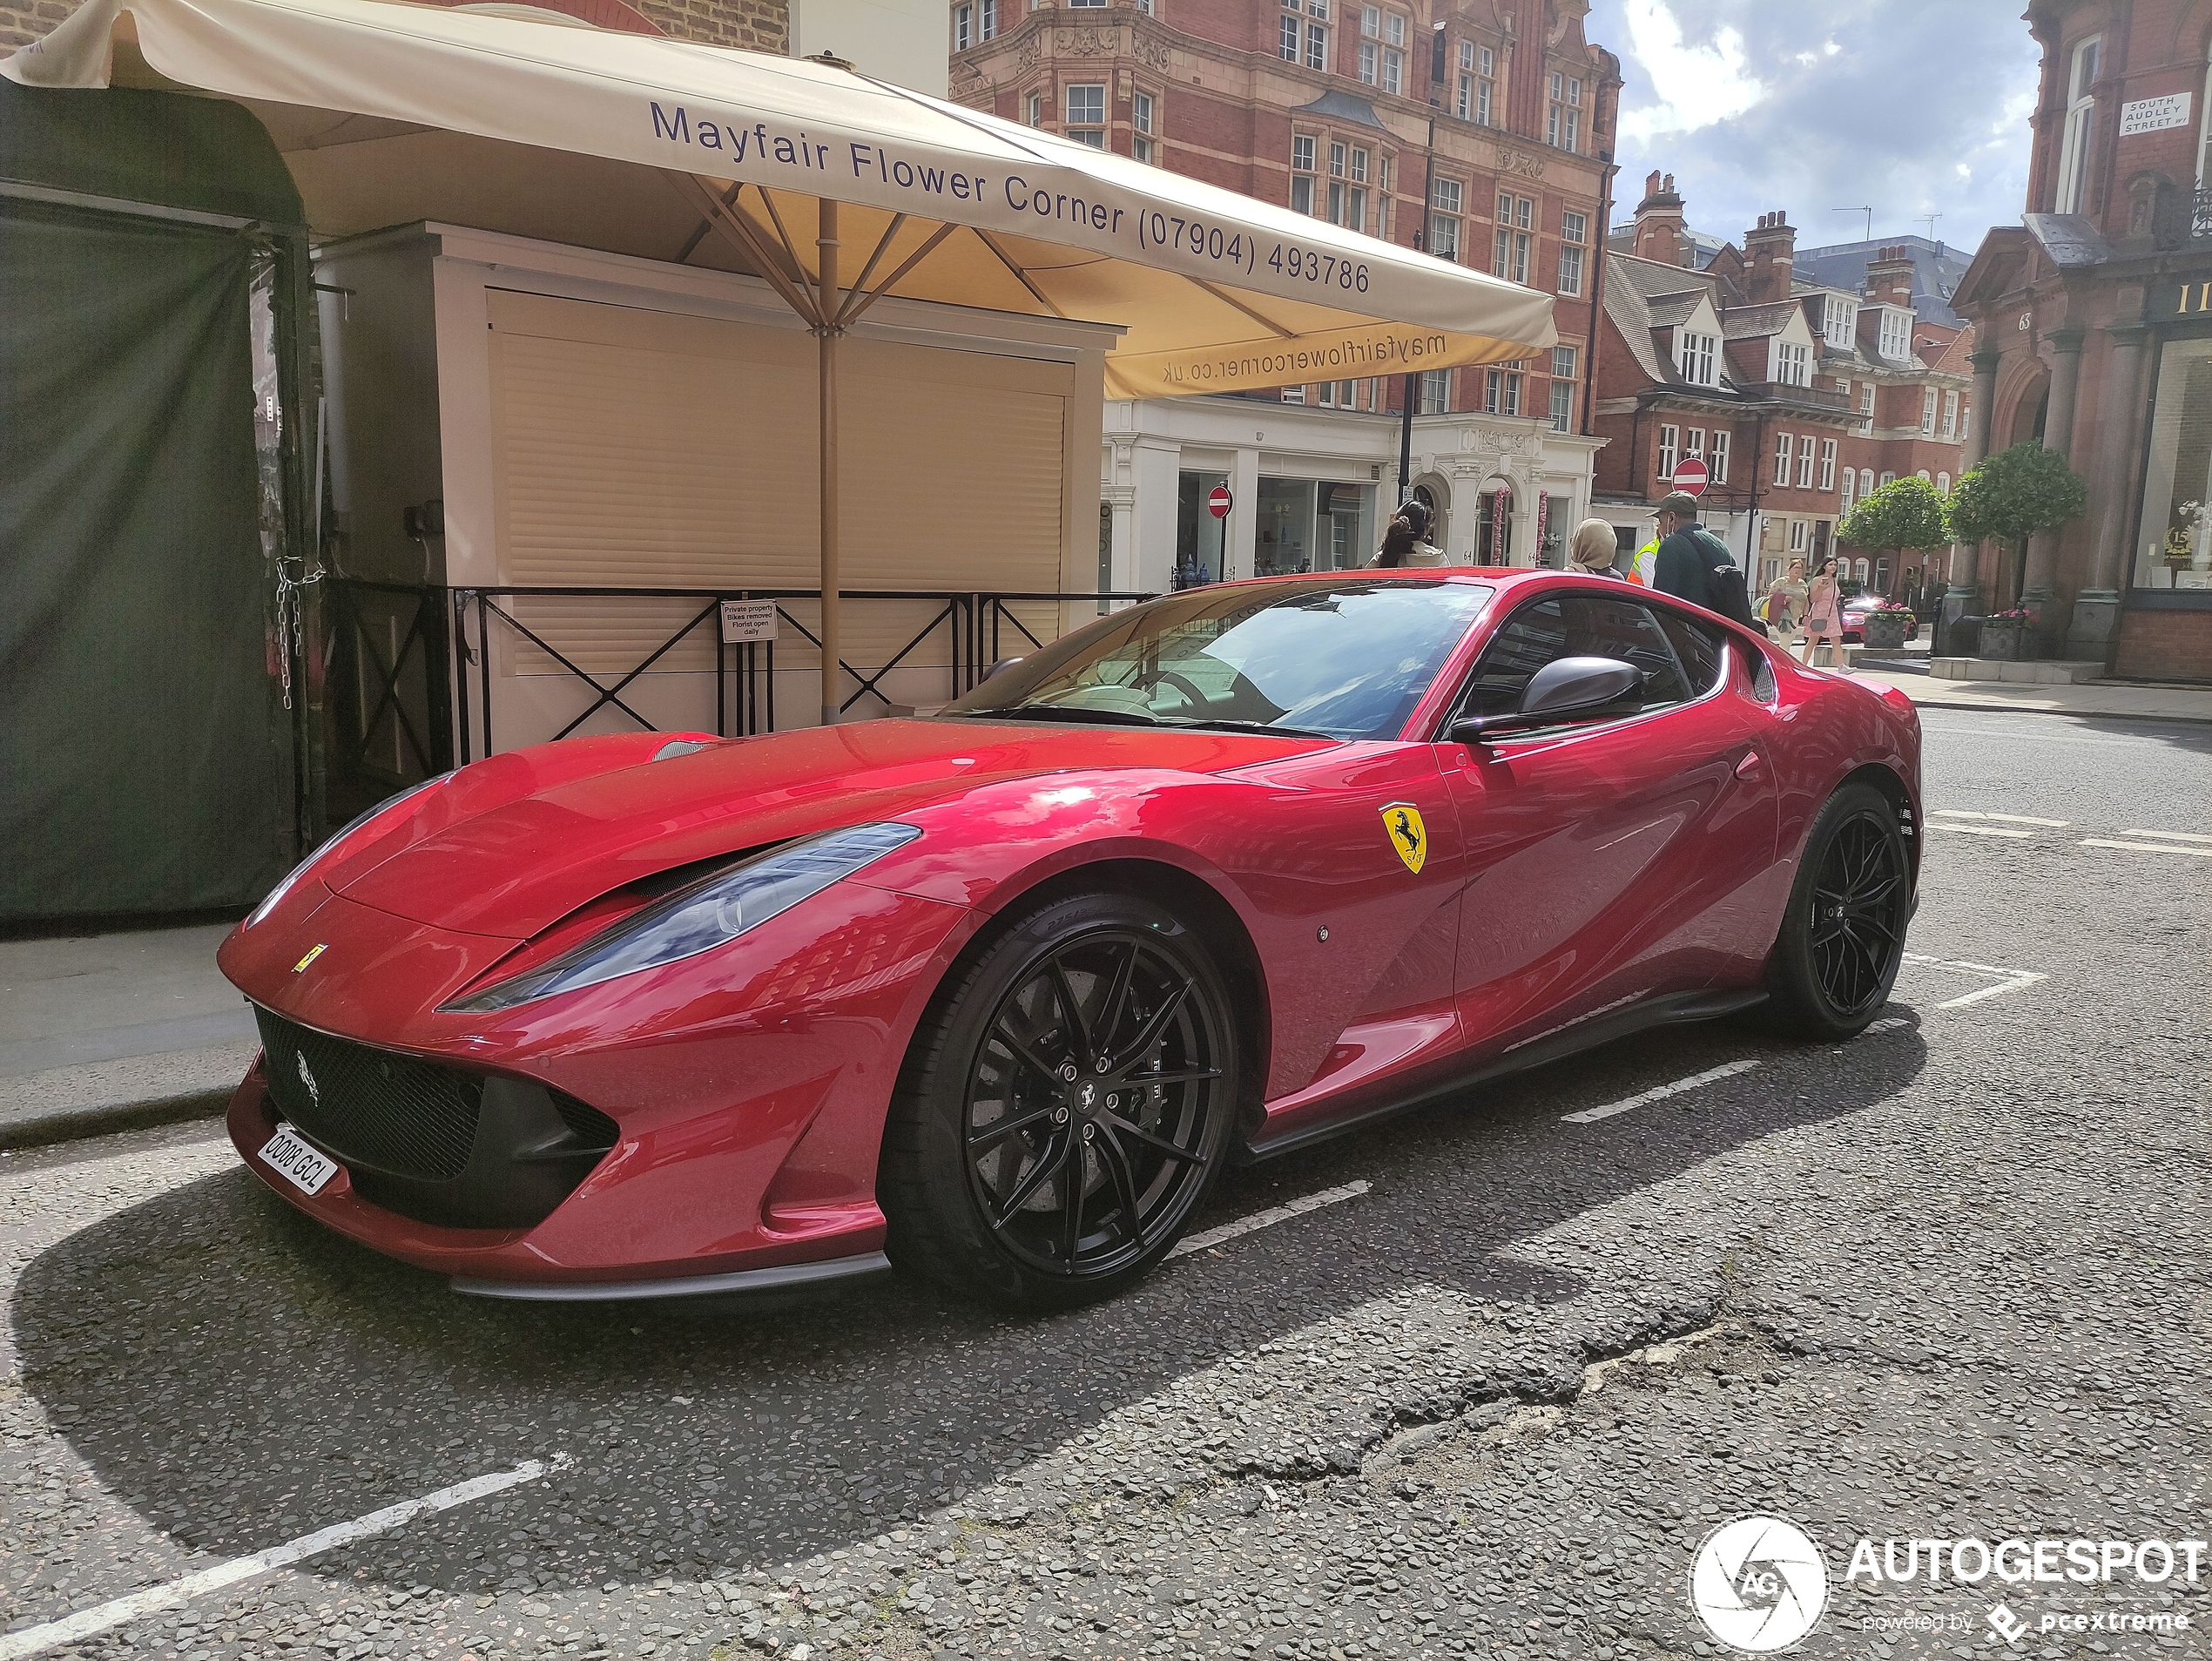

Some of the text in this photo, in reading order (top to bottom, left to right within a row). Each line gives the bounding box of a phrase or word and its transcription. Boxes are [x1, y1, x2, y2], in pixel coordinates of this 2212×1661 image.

[2130, 97, 2175, 111] SOUTH
[2125, 105, 2182, 122] AUDLEY
[2125, 118, 2172, 132] STREET
[650, 101, 1369, 294] Mayfair Flower Corner (07904) 493786
[2019, 312, 2032, 331] 63
[2173, 530, 2188, 544] 15
[1463, 550, 1472, 561] 64
[1527, 552, 1535, 562] 64
[292, 1154, 327, 1189] GCL
